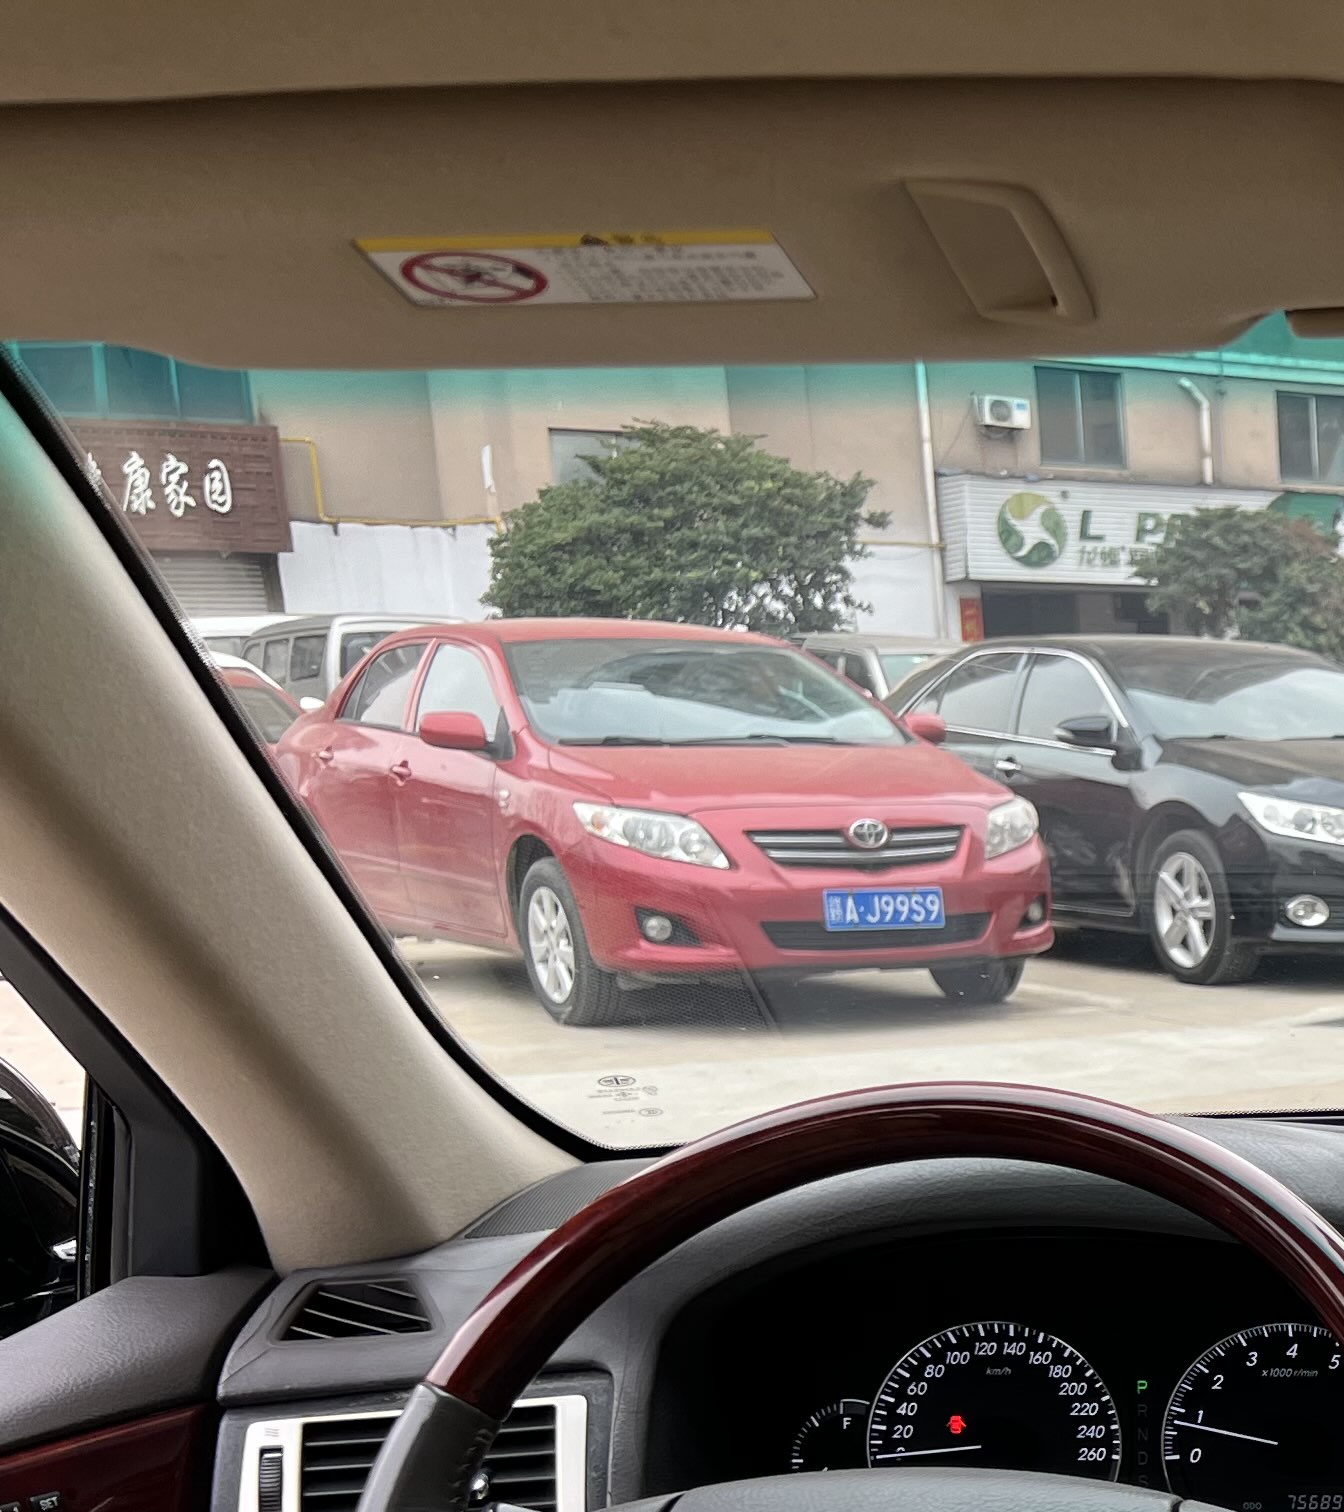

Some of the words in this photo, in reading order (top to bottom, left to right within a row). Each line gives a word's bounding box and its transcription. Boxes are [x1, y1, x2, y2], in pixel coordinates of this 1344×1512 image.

[974, 1342, 997, 1355] 120
[1003, 1342, 1026, 1355] 140
[1286, 1343, 1298, 1358] 4
[946, 1352, 969, 1364] 100
[1029, 1352, 1052, 1364] 160
[1246, 1352, 1258, 1366] 3
[1328, 1355, 1341, 1369] 5
[924, 1365, 945, 1378] 80
[985, 1366, 1011, 1376] km/h
[1048, 1365, 1072, 1378] 180
[907, 1382, 927, 1395] 60
[1059, 1382, 1087, 1395] 200
[1137, 1380, 1148, 1394] P
[1211, 1375, 1224, 1389] 2
[896, 1403, 917, 1415] 40
[1070, 1403, 1098, 1415] 220
[1197, 1410, 1204, 1423] 1
[843, 1418, 851, 1430] F
[892, 1425, 913, 1438] 20
[1076, 1425, 1105, 1438] 240
[1077, 1448, 1106, 1461] 260
[1190, 1448, 1201, 1463] 0
[39, 1496, 58, 1511] SET
[1288, 1495, 1343, 1510] 75689
